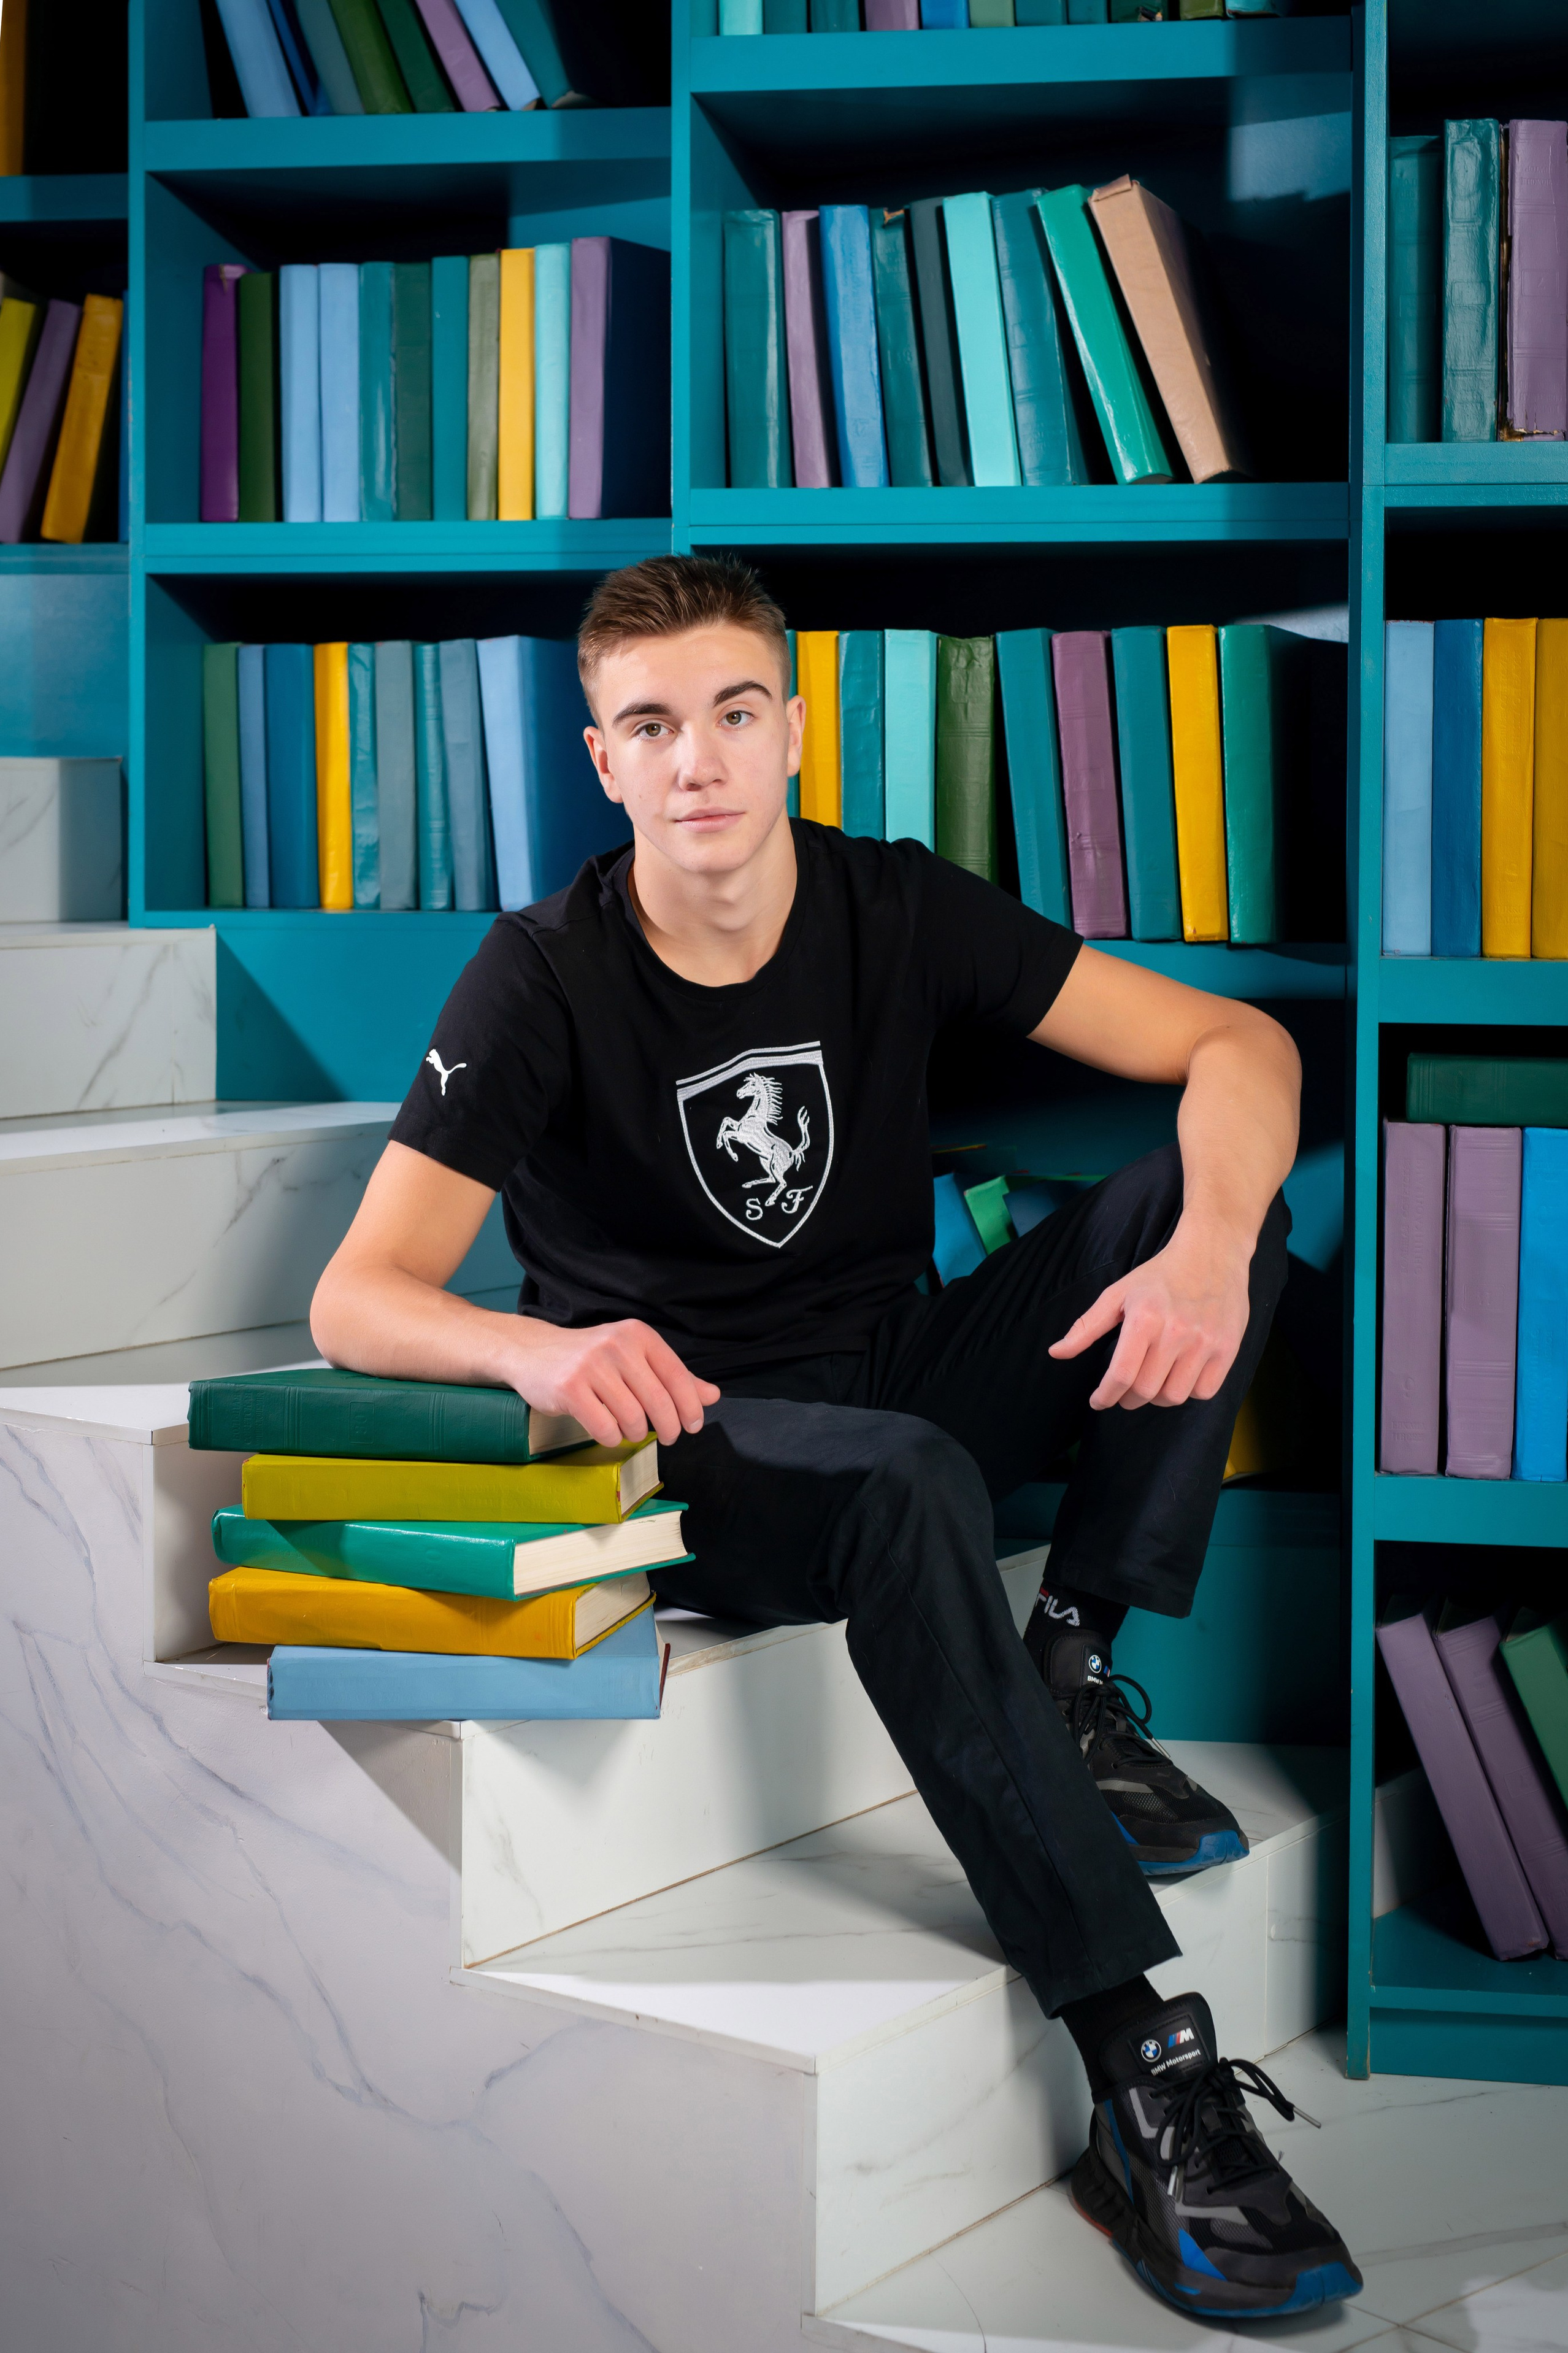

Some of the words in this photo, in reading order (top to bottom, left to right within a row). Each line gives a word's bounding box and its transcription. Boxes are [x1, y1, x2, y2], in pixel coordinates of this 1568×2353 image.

[745, 1198, 764, 1221] S
[780, 1185, 813, 1214] F
[1035, 1587, 1080, 1627] FILA
[1087, 1675, 1100, 1684] BMW
[1151, 2062, 1167, 2076] BMW
[1166, 2049, 1201, 2068] Motorsport
